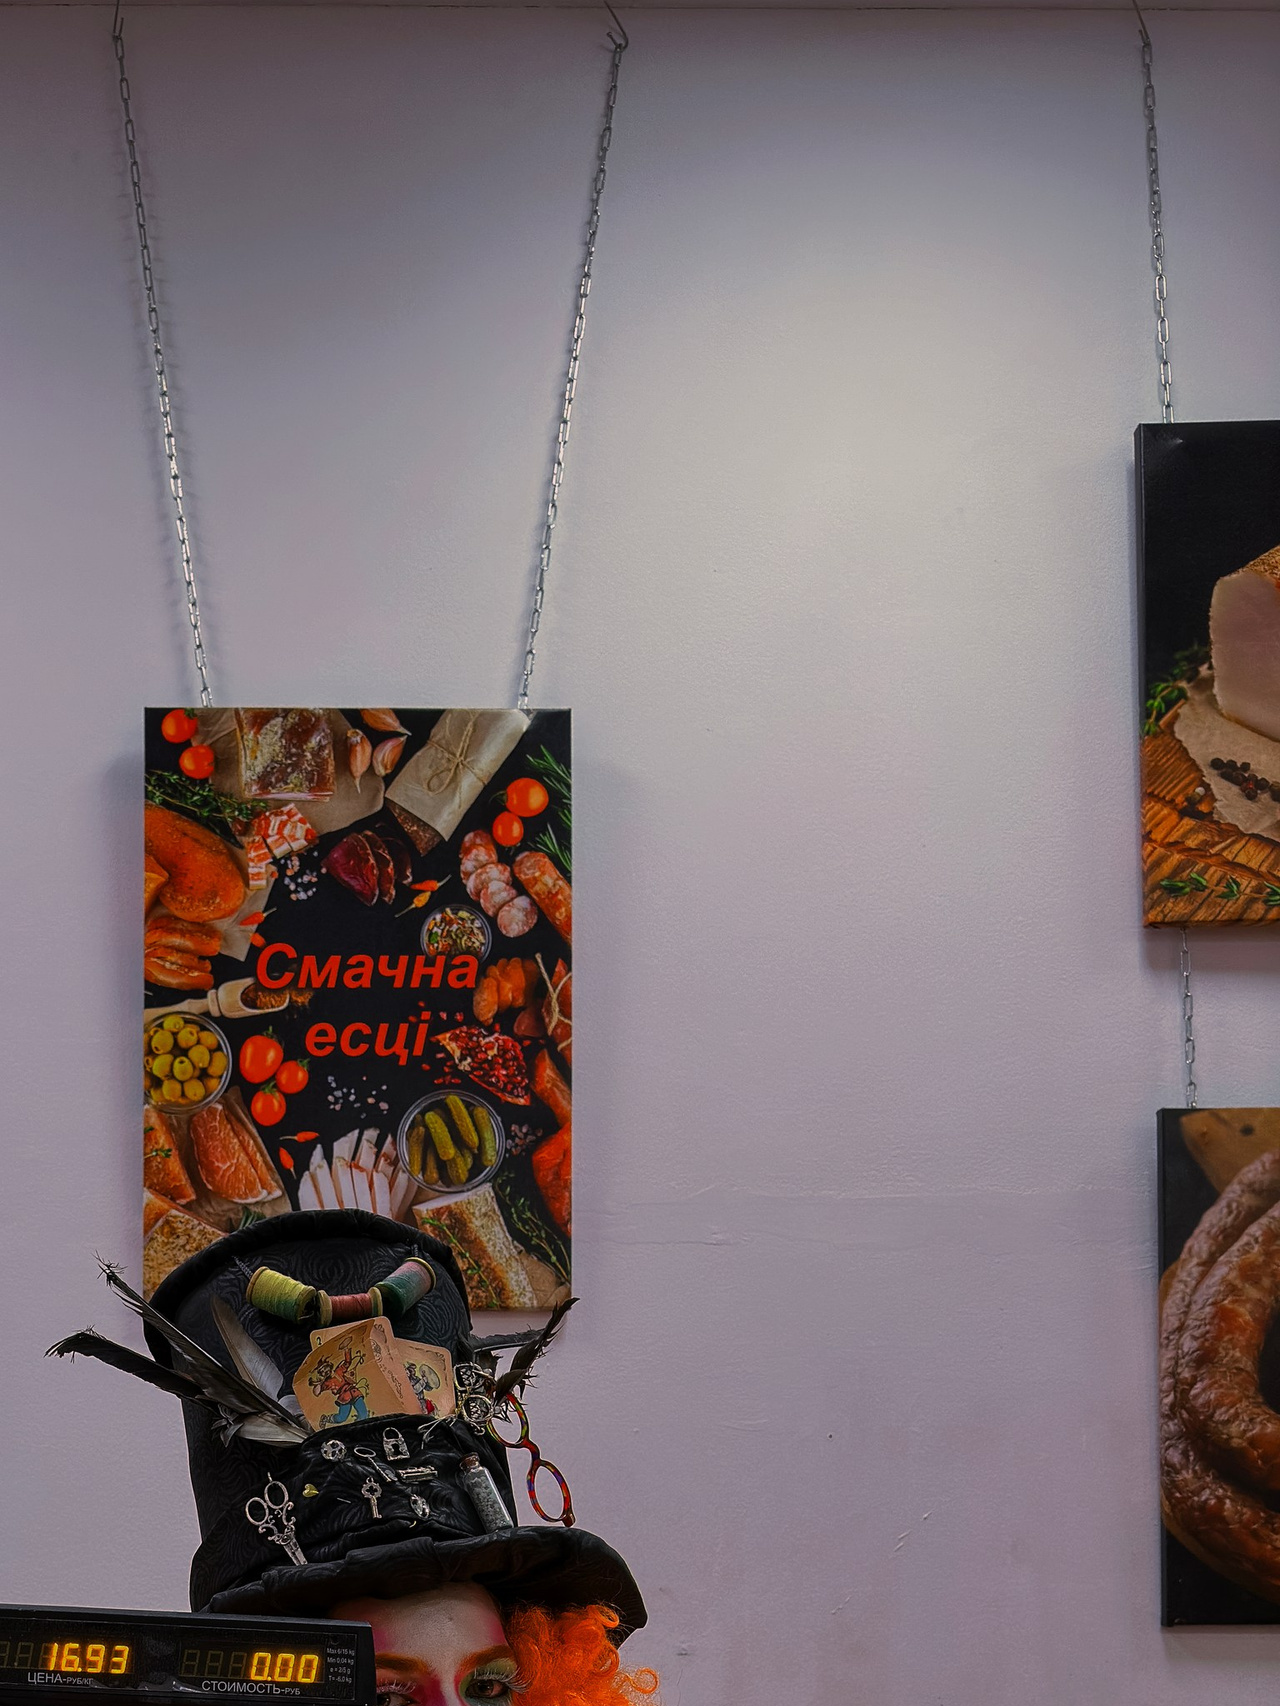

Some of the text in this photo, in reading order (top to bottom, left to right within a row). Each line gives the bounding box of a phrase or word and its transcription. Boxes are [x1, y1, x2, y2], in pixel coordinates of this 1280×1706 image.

[256, 942, 480, 989] Смачна
[305, 1003, 432, 1065] есці
[49, 1642, 130, 1674] 16.93
[250, 1652, 319, 1683] 0.00
